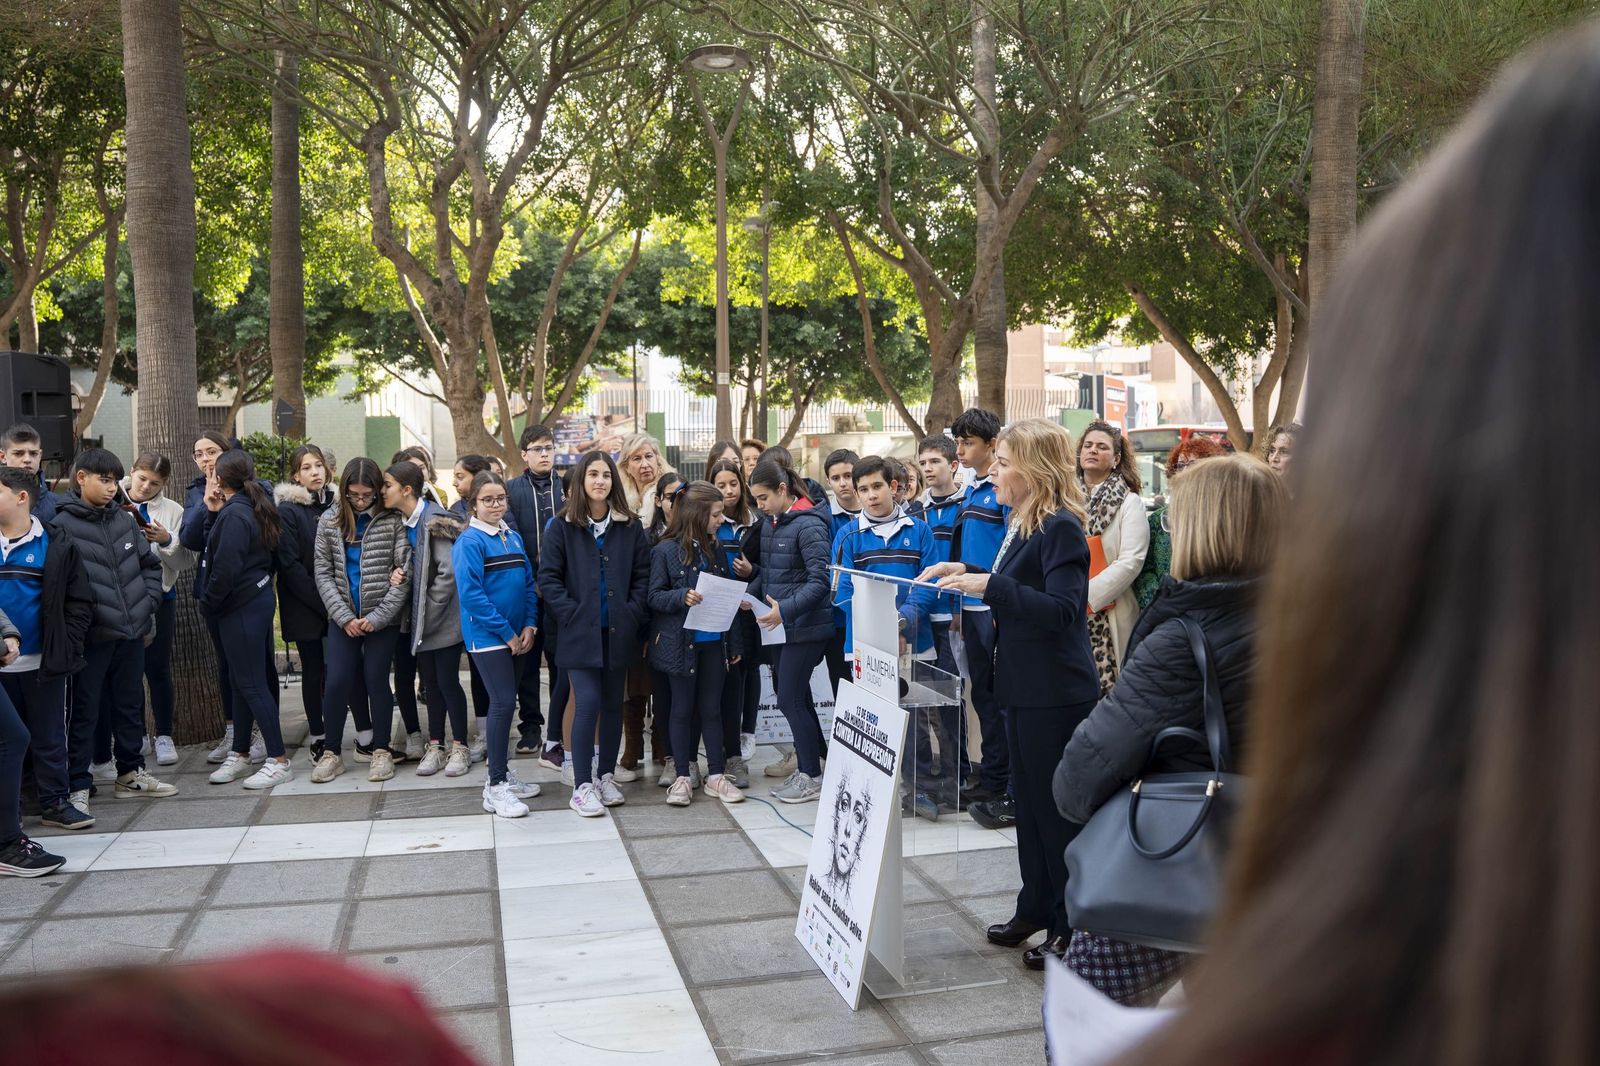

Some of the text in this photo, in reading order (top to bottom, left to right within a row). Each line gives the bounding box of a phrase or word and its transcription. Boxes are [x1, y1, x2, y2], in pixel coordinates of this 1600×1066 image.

[866, 655, 896, 682] ALMERÍA
[866, 711, 879, 726] ENERO
[836, 722, 892, 770] CONTRA LA DEPRESIÓN
[876, 728, 889, 745] LUCHA
[809, 874, 821, 896] Hablar
